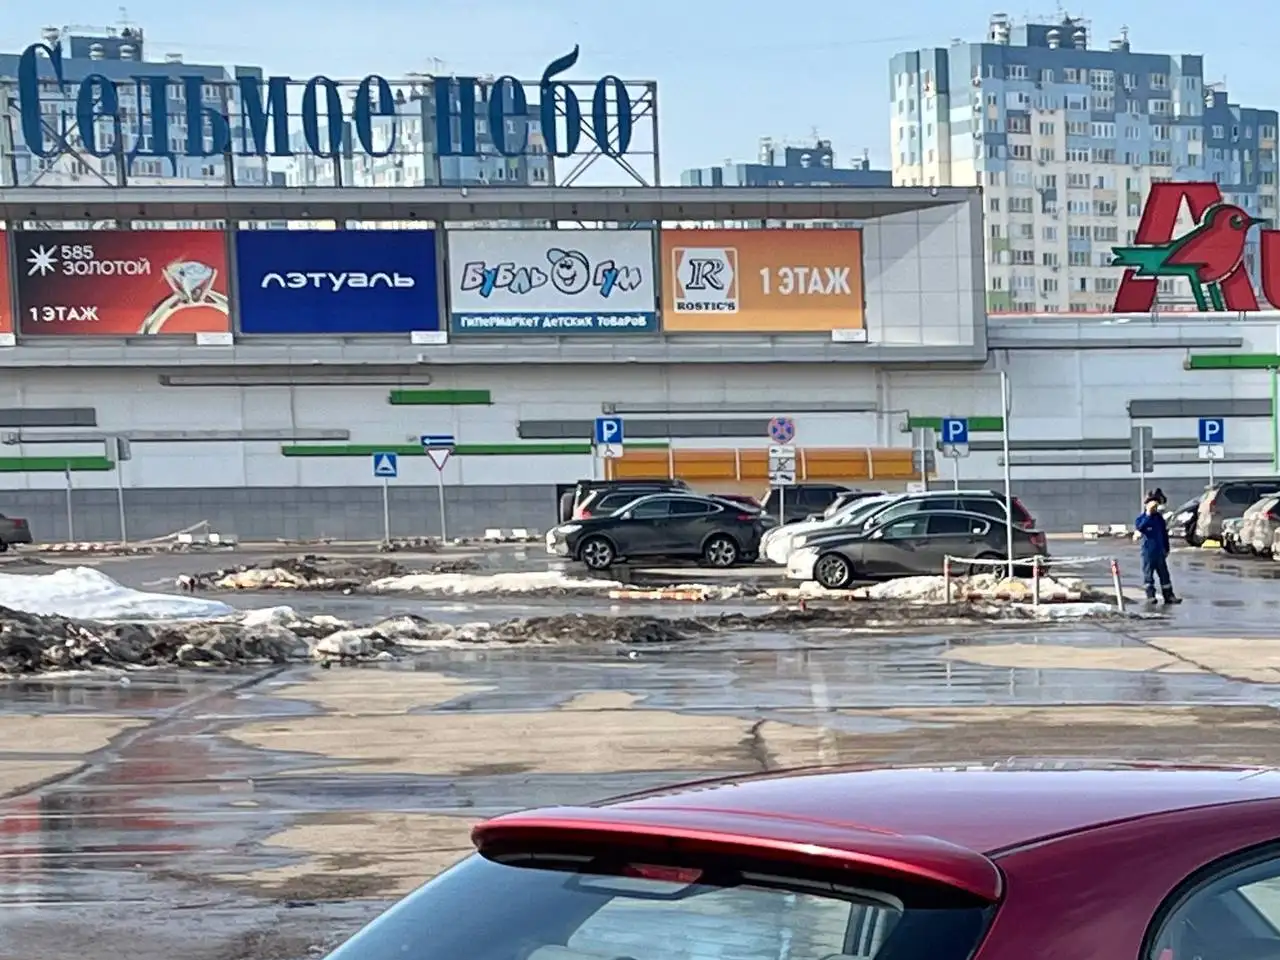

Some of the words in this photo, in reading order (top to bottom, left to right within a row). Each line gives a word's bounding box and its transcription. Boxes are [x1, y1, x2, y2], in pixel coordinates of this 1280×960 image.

[18, 43, 396, 176] Седьмое
[434, 45, 632, 158] небо
[61, 245, 94, 259] 585
[62, 258, 151, 276] ЗОЛОТОЙ
[759, 267, 770, 295] 1
[778, 267, 851, 295] ЭТАЖ
[29, 307, 38, 321] 1
[43, 306, 99, 321] ЭТАЖ
[676, 301, 736, 311] ROSTIC'S
